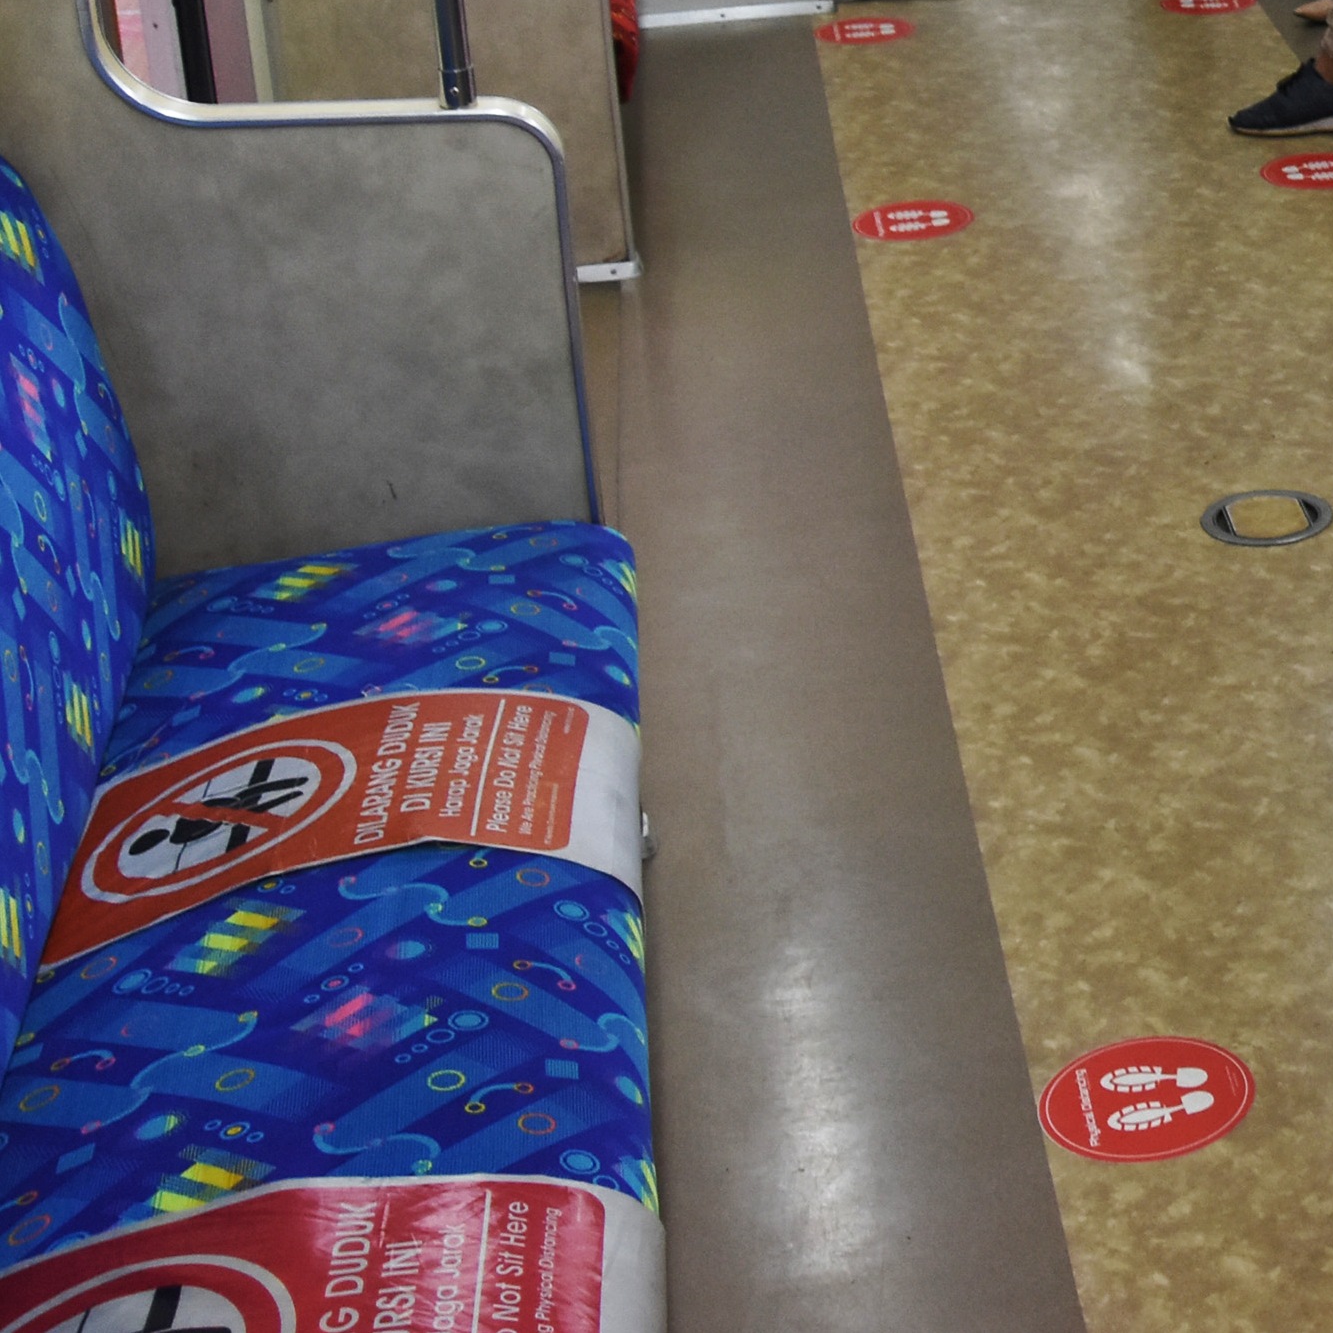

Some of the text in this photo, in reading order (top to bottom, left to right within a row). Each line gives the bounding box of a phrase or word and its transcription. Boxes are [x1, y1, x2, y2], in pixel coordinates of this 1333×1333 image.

[353, 701, 422, 845] DILARANG DUDUK
[400, 721, 453, 813] DI KURSI INI
[438, 713, 485, 818] Harap Jaga Jarak
[486, 704, 533, 834] Please Do Not Sit Here
[522, 803, 535, 821] Are
[518, 820, 533, 836] We
[324, 1200, 379, 1299] DUDUK
[433, 1223, 466, 1279] Jarak
[491, 1200, 530, 1323] Not Sit Here
[538, 1206, 563, 1270] Distancing
[372, 1238, 423, 1333] RSI INI
[534, 1269, 557, 1321] Physical
